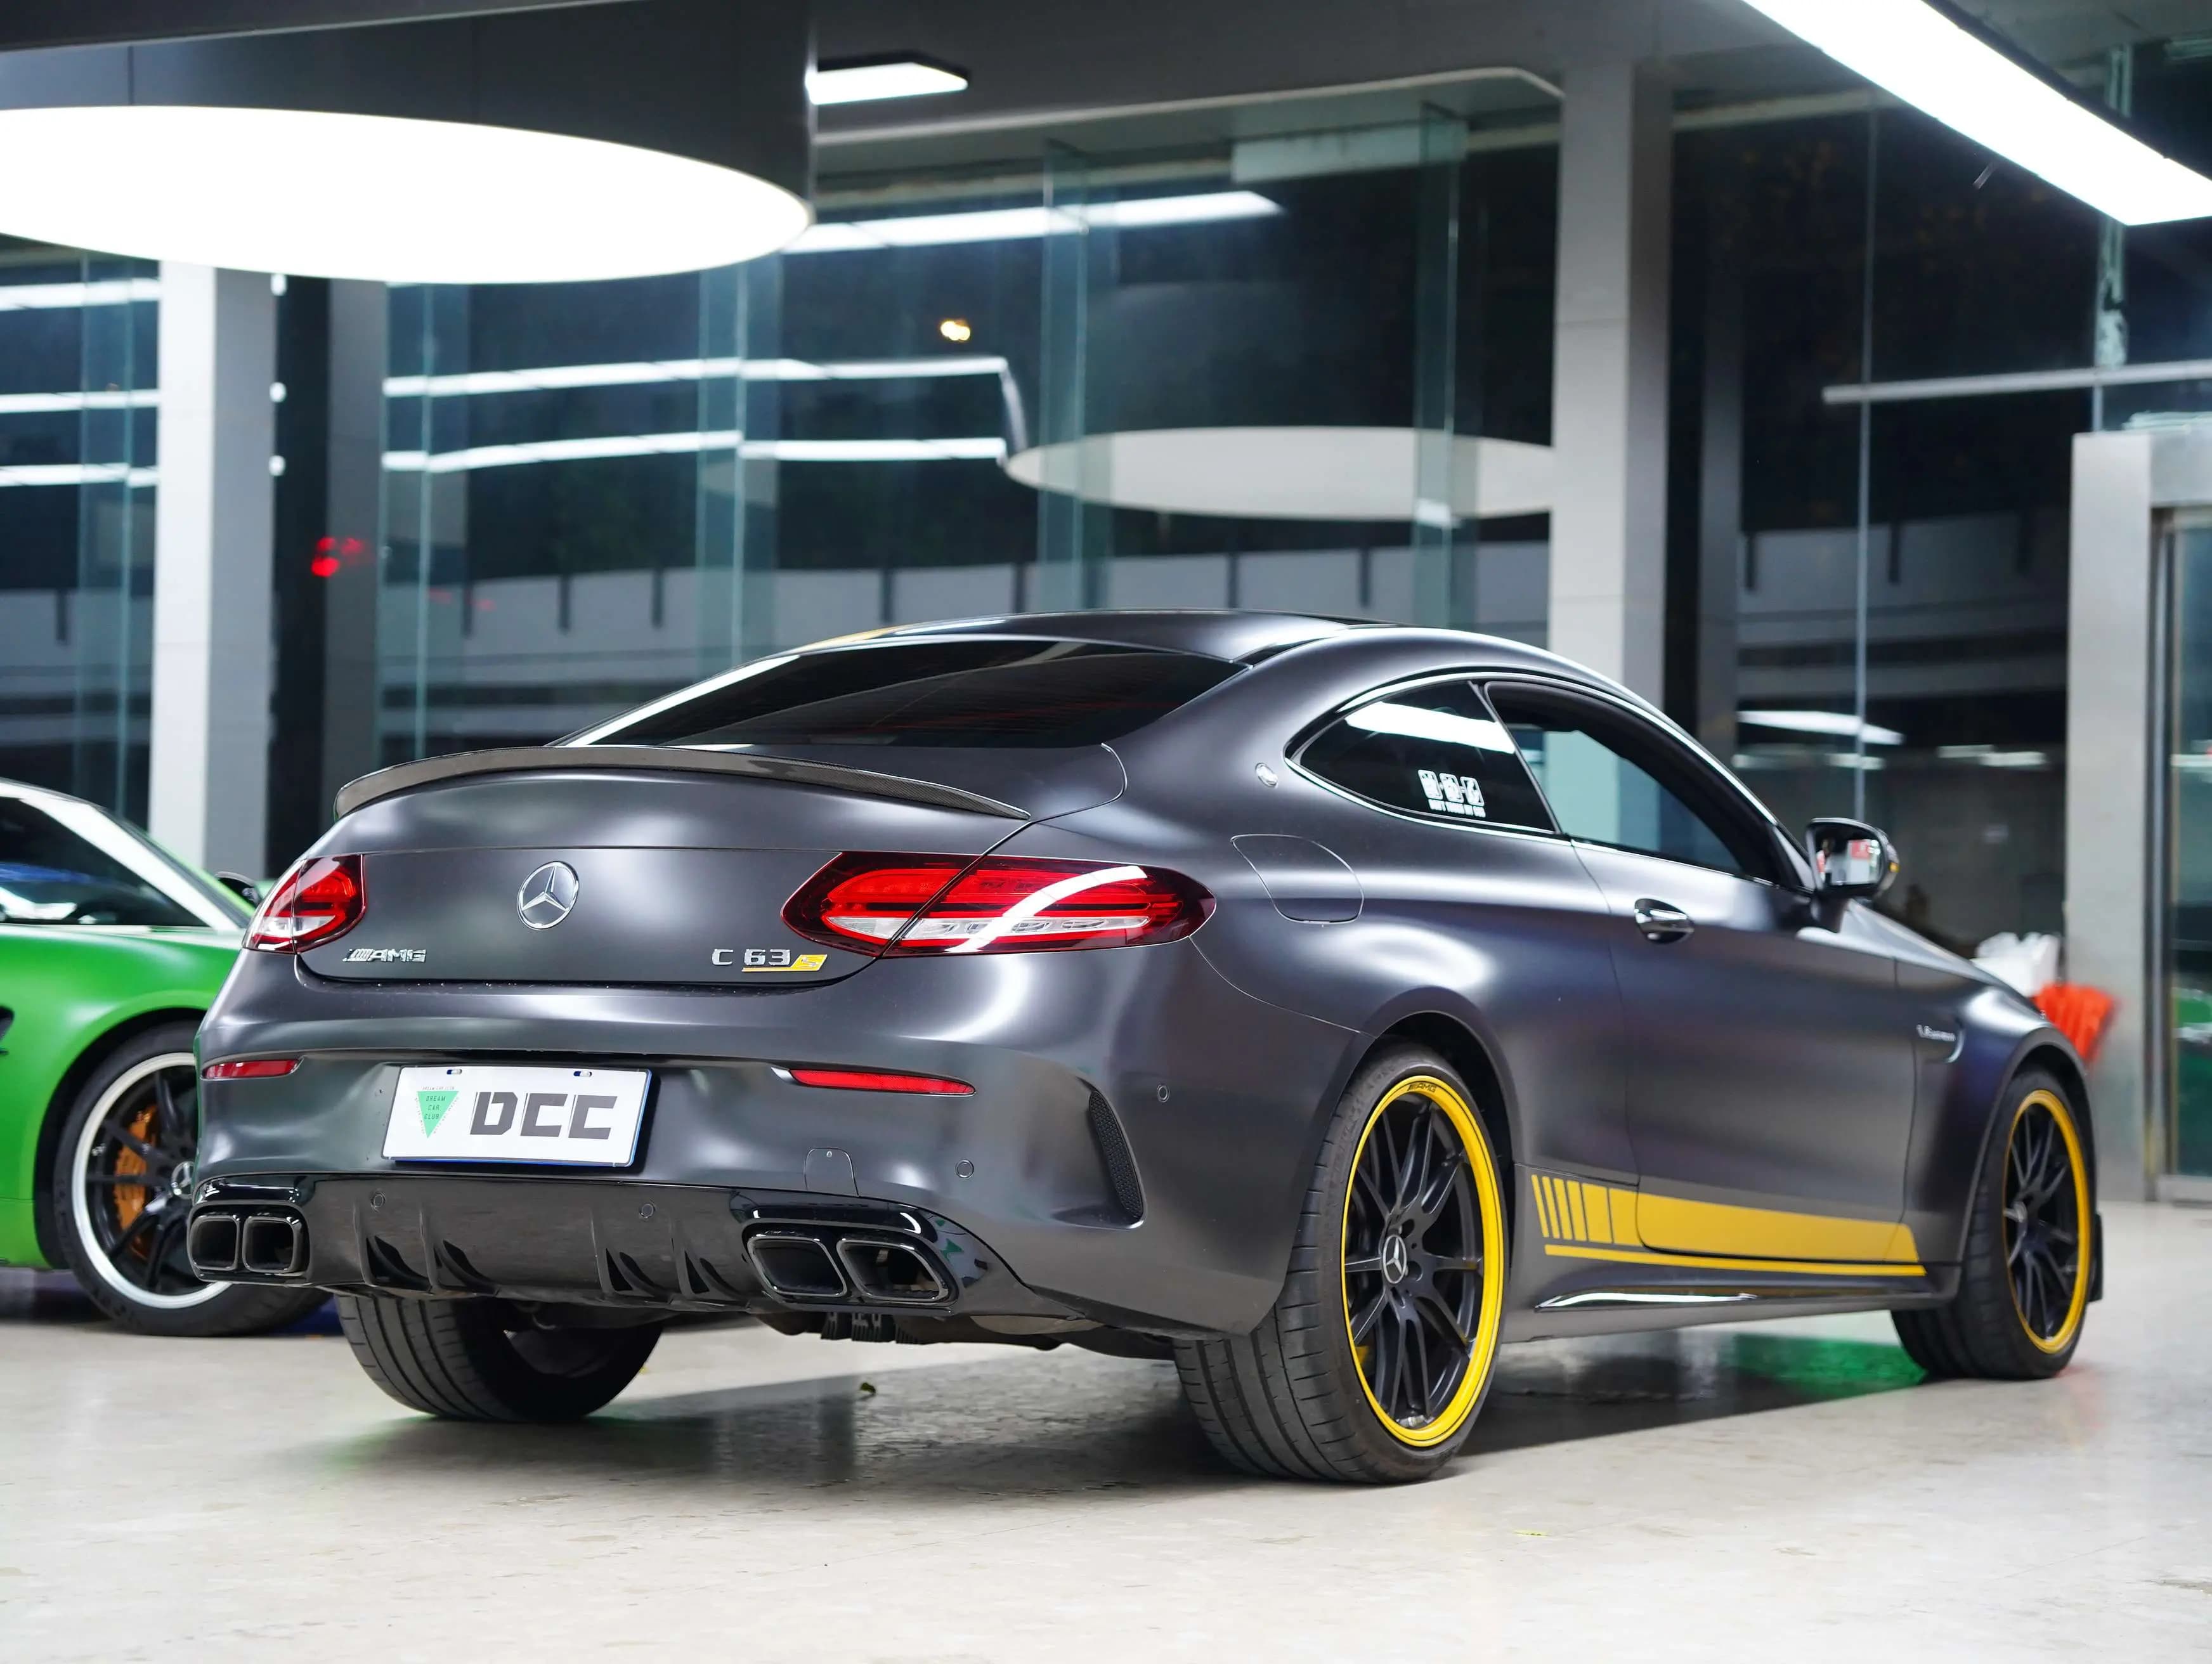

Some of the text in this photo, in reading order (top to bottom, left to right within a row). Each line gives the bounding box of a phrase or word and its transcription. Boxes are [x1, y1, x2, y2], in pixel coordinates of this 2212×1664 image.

[367, 948, 427, 963] AMG
[712, 948, 819, 968] C 63 S
[469, 1091, 618, 1140] DCC
